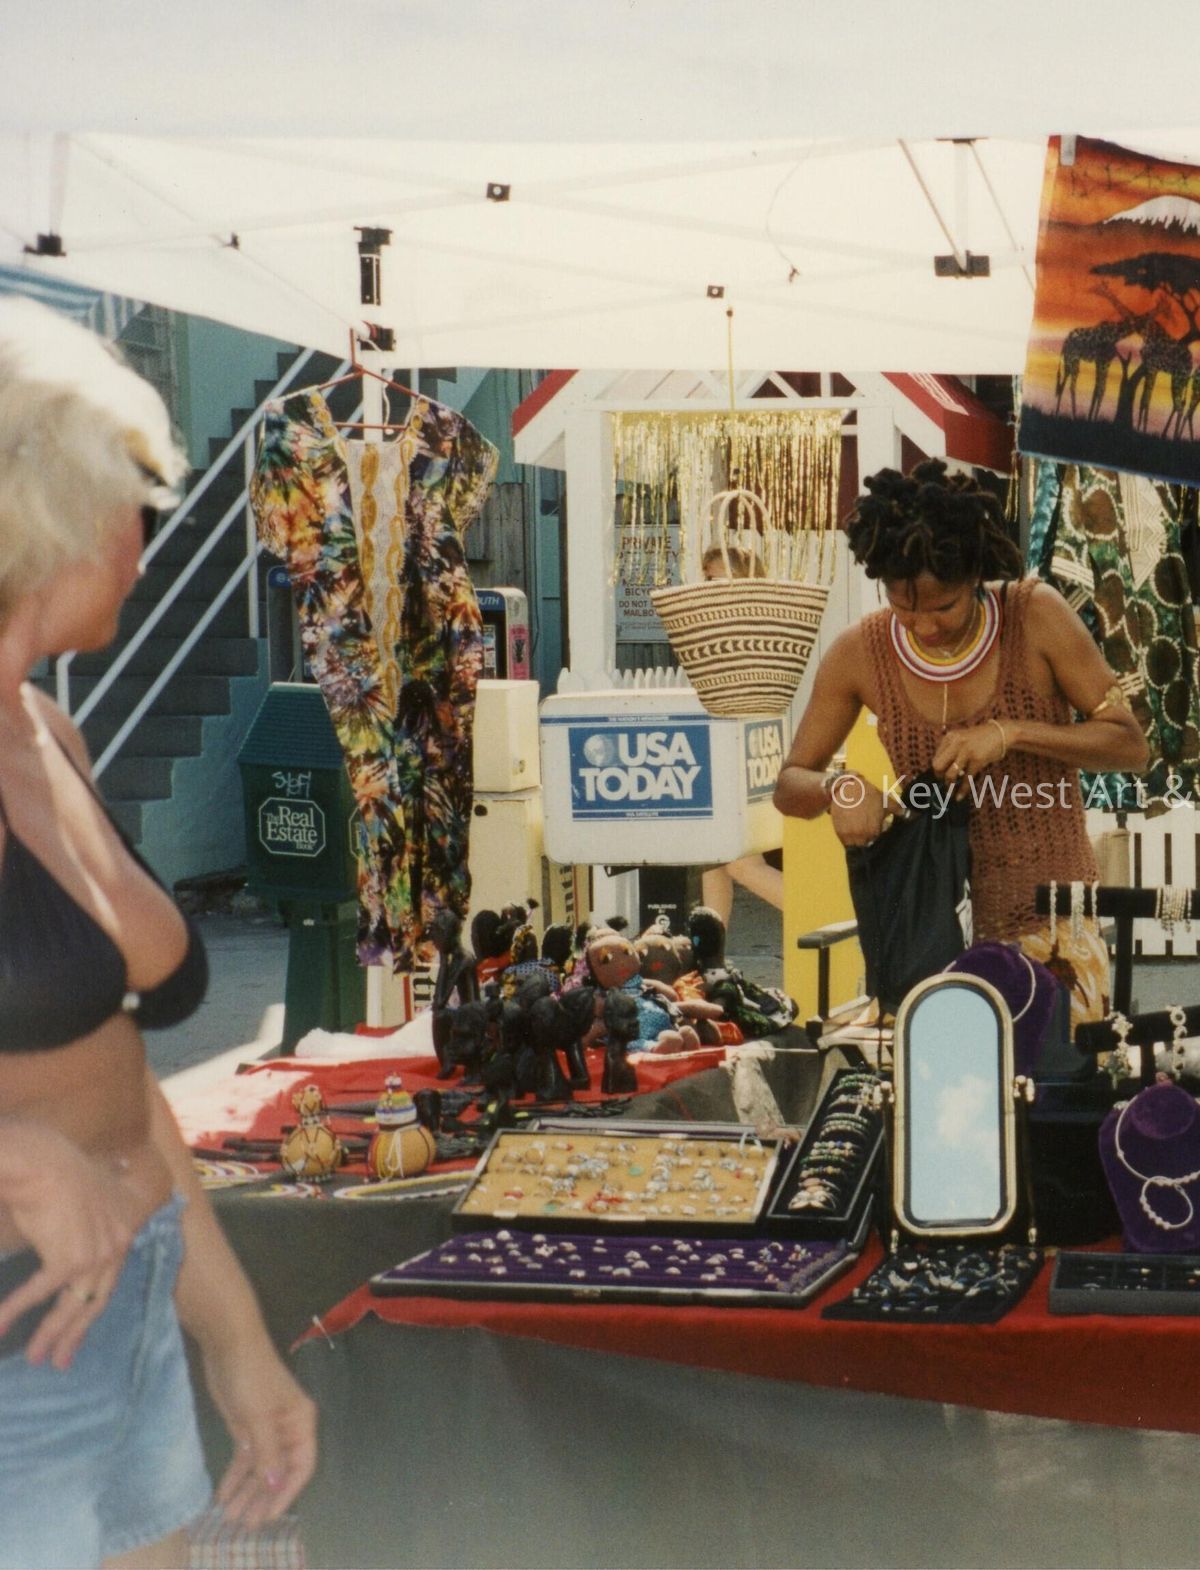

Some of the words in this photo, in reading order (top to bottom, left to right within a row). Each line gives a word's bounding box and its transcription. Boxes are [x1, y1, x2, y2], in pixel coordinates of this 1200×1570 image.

[618, 600, 630, 608] DO
[632, 600, 648, 608] NOT
[623, 609, 656, 617] MAILBO
[618, 732, 697, 766] USA
[759, 724, 782, 757] USA
[579, 766, 702, 801] TODAY
[278, 806, 315, 828] Real
[266, 820, 318, 844] Estate
